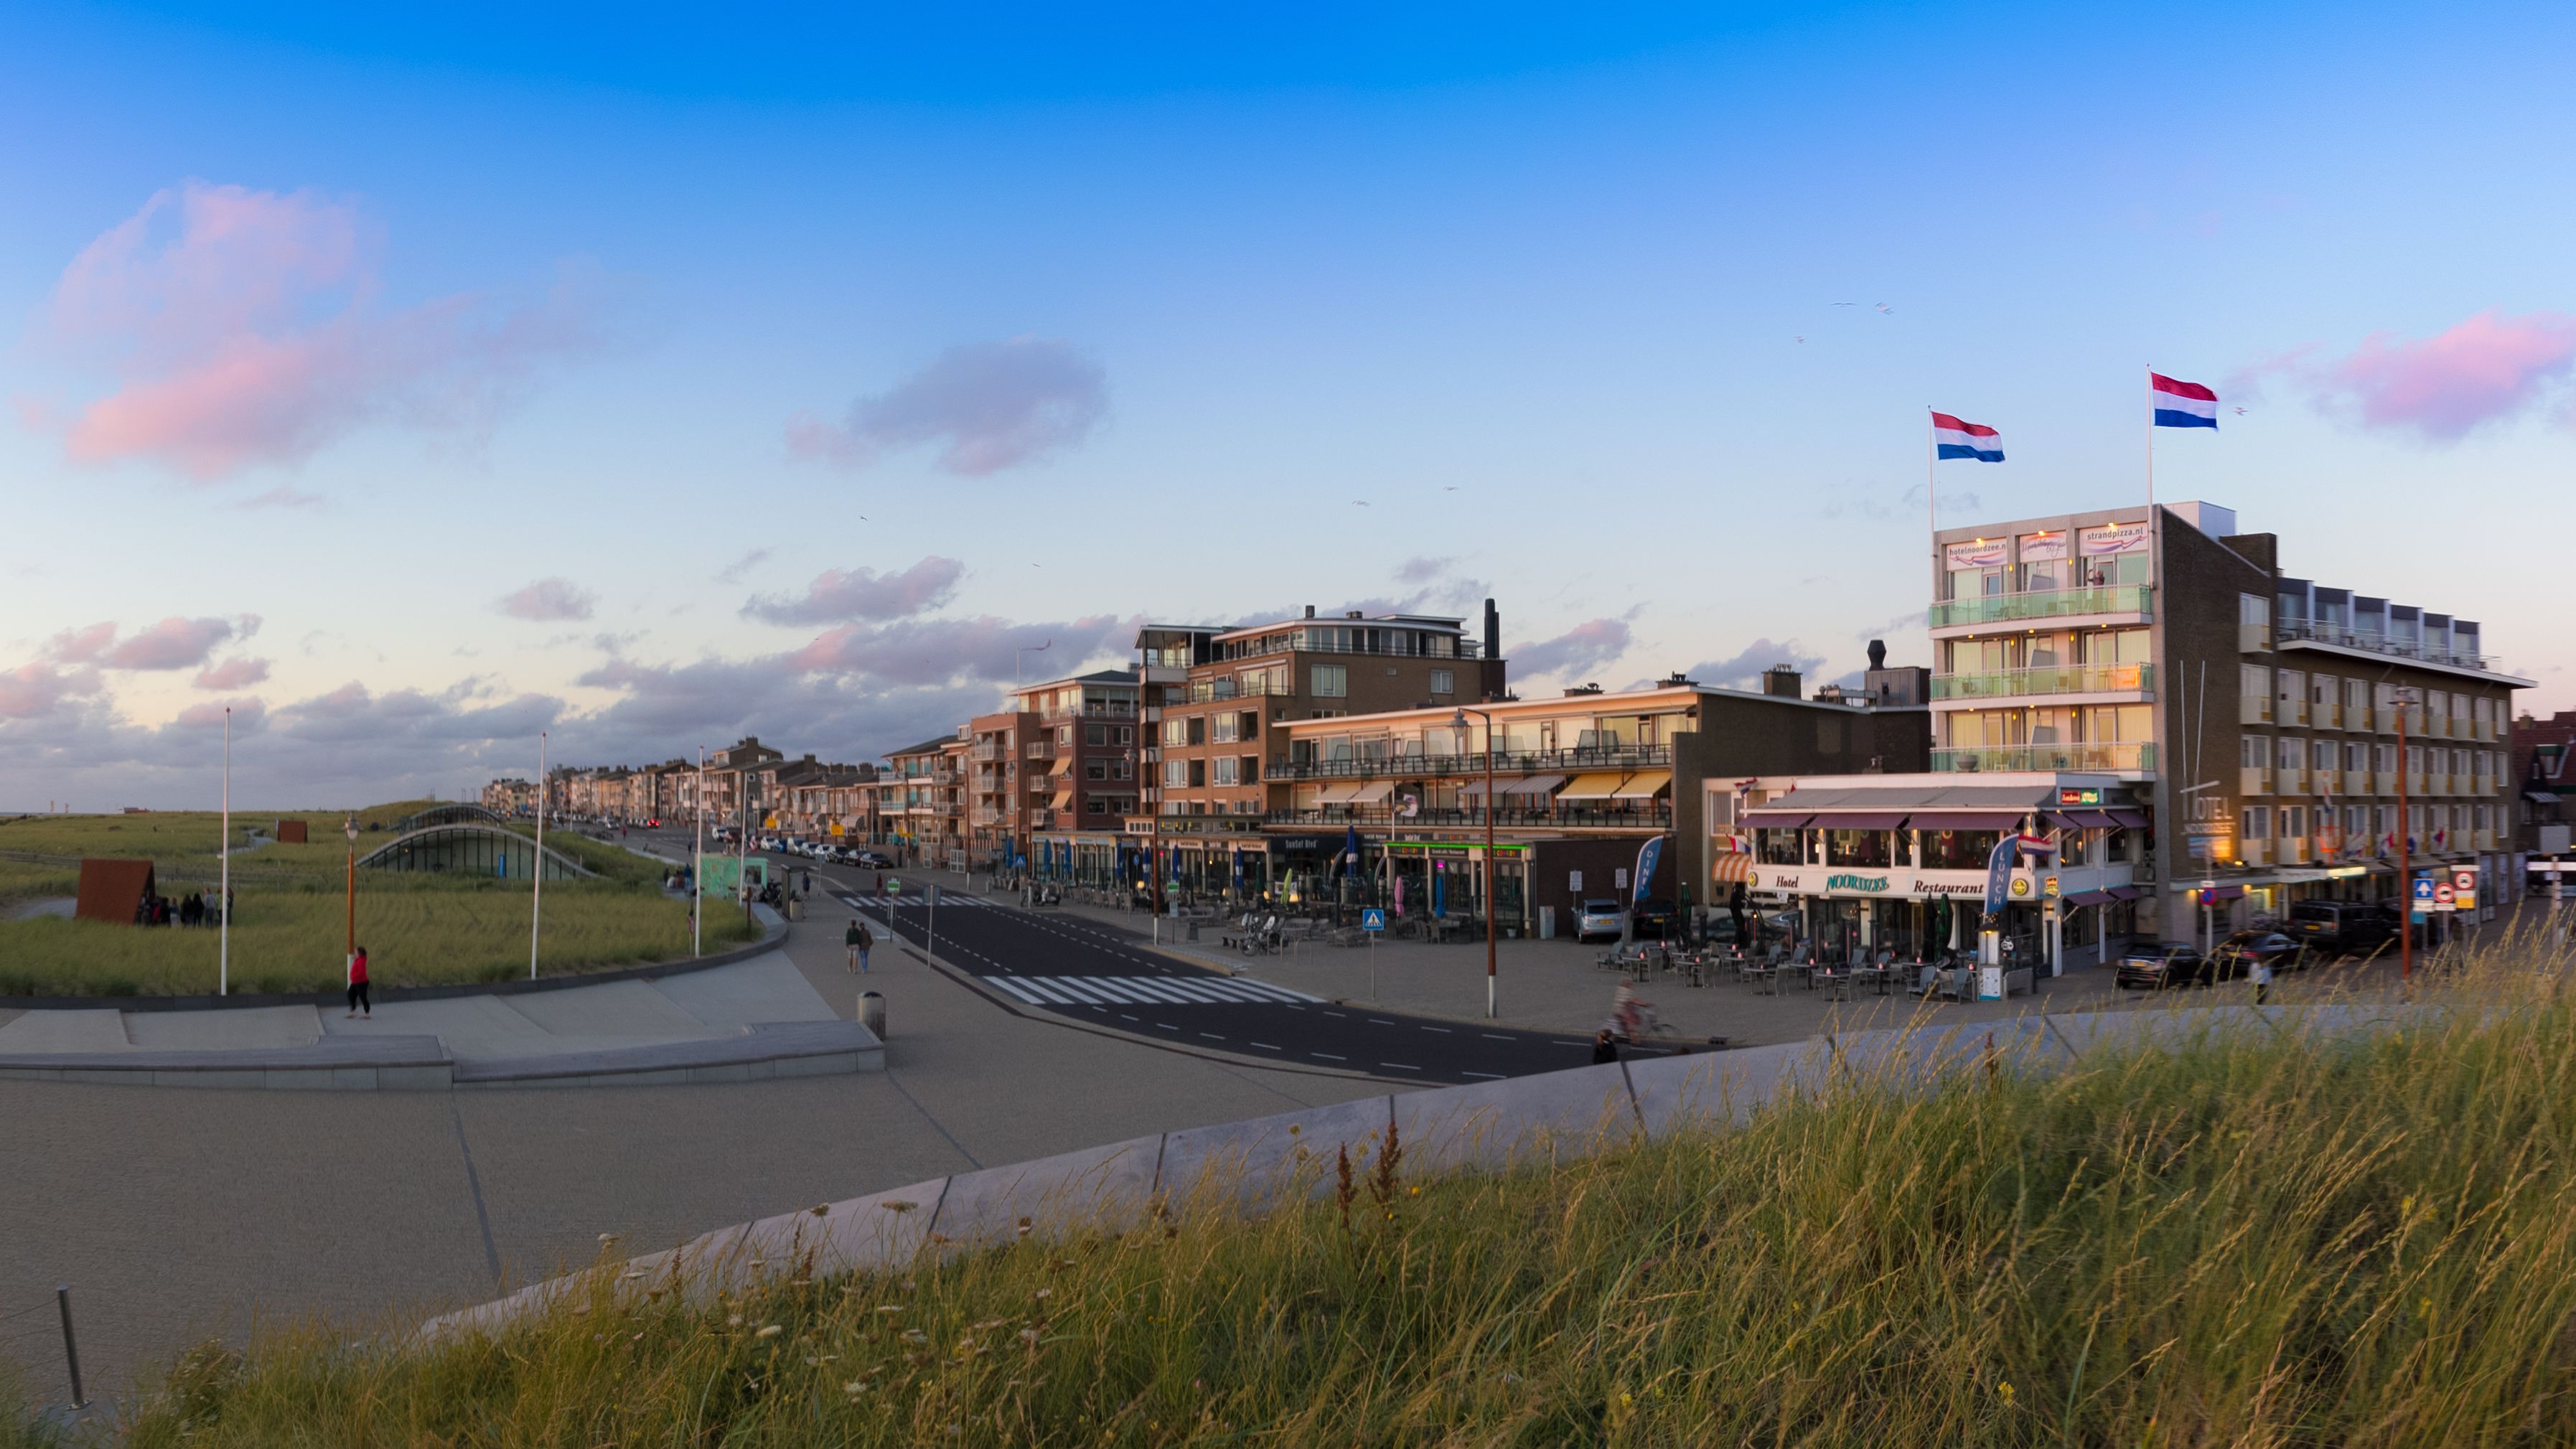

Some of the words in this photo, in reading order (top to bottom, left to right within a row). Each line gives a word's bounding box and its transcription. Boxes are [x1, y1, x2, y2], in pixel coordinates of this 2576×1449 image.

[2087, 527, 2143, 540] strandpizza.nl
[1949, 544, 2006, 555] hotelnoordzee.n
[1776, 876, 1799, 888] Hotel
[1825, 874, 1890, 892] NOORDZEE
[1914, 880, 1984, 894] Restaurant
[1994, 852, 2006, 905] LUNCH
